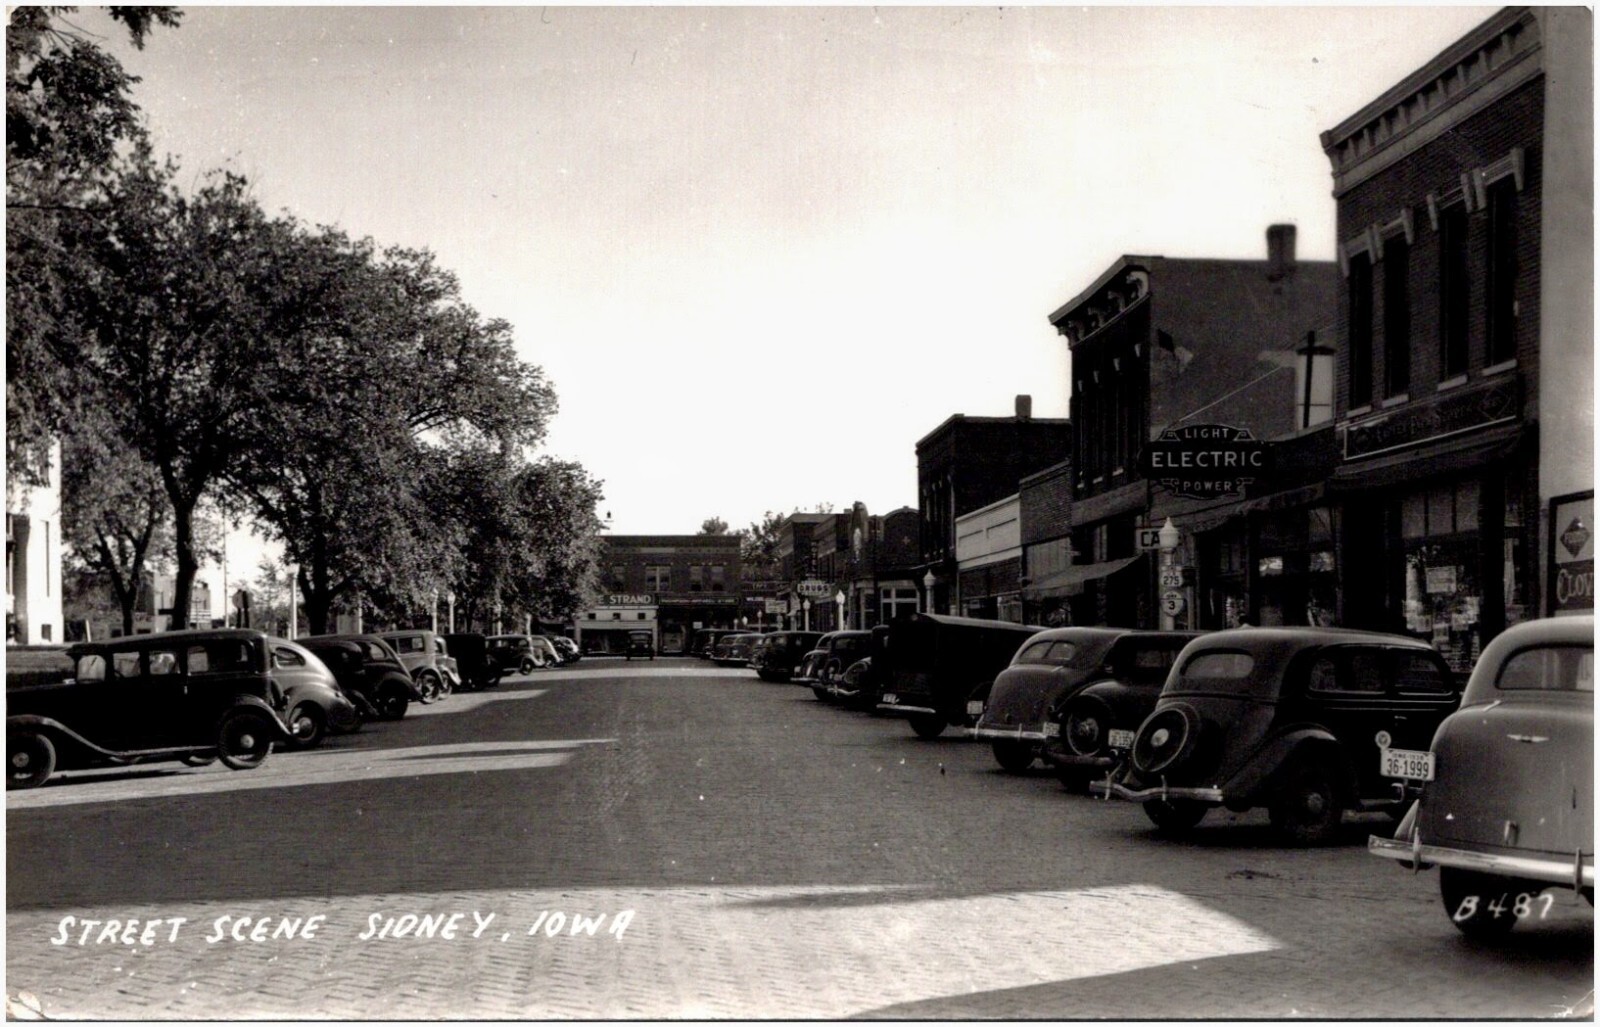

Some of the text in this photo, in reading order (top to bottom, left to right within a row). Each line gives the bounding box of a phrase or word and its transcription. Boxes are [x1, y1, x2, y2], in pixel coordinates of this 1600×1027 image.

[1185, 428, 1230, 439] LIGHT
[1151, 450, 1263, 468] ELECTRIC
[1183, 480, 1233, 492] POWER
[1163, 576, 1180, 586] 275
[799, 584, 829, 594] DRUGS
[609, 594, 652, 604] STRAND
[1168, 600, 1176, 610] 3
